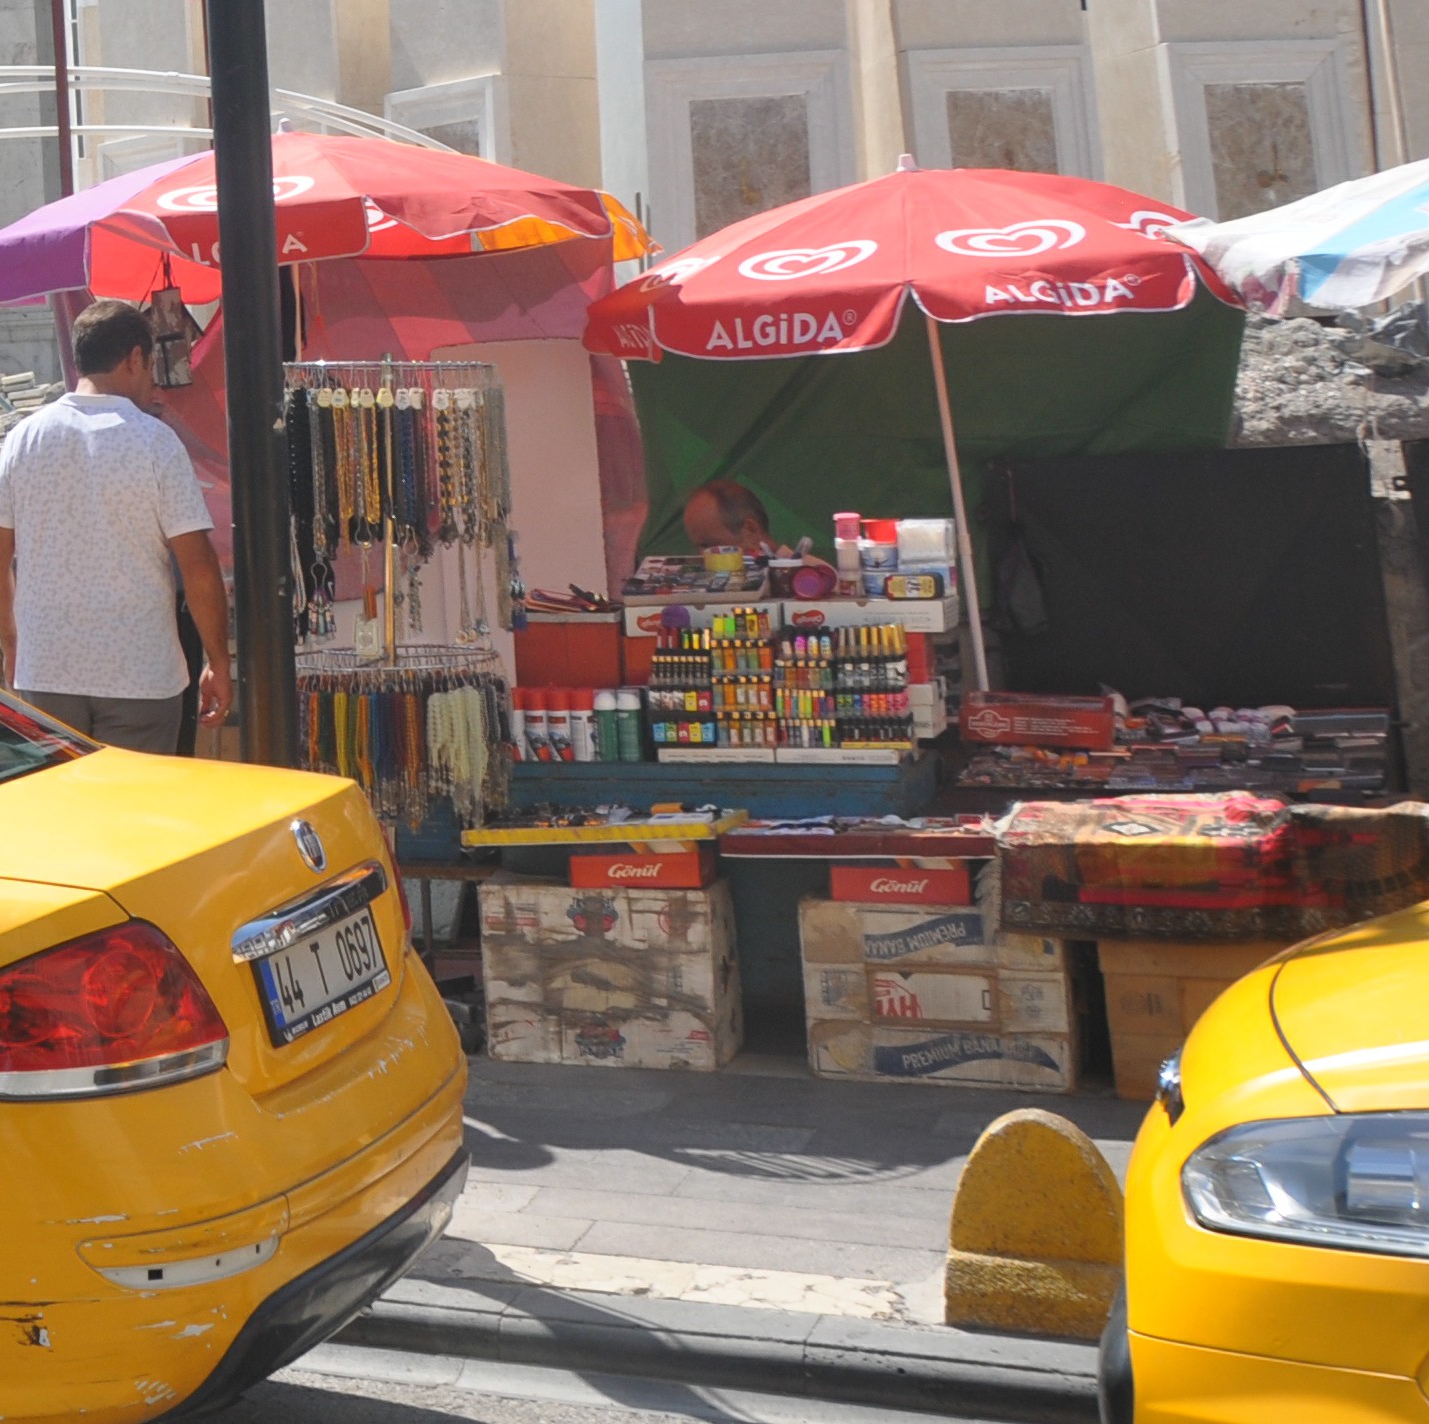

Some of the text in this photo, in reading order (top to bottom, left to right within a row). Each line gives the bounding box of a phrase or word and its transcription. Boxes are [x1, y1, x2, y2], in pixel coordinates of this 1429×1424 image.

[985, 278, 1134, 307] ALGiDA
[706, 311, 843, 350] ALGiDA
[608, 863, 662, 878] Gönül
[870, 878, 928, 894] Gönül
[274, 915, 377, 1014] 44 T 0697
[902, 1042, 961, 1071] PREMIUM
